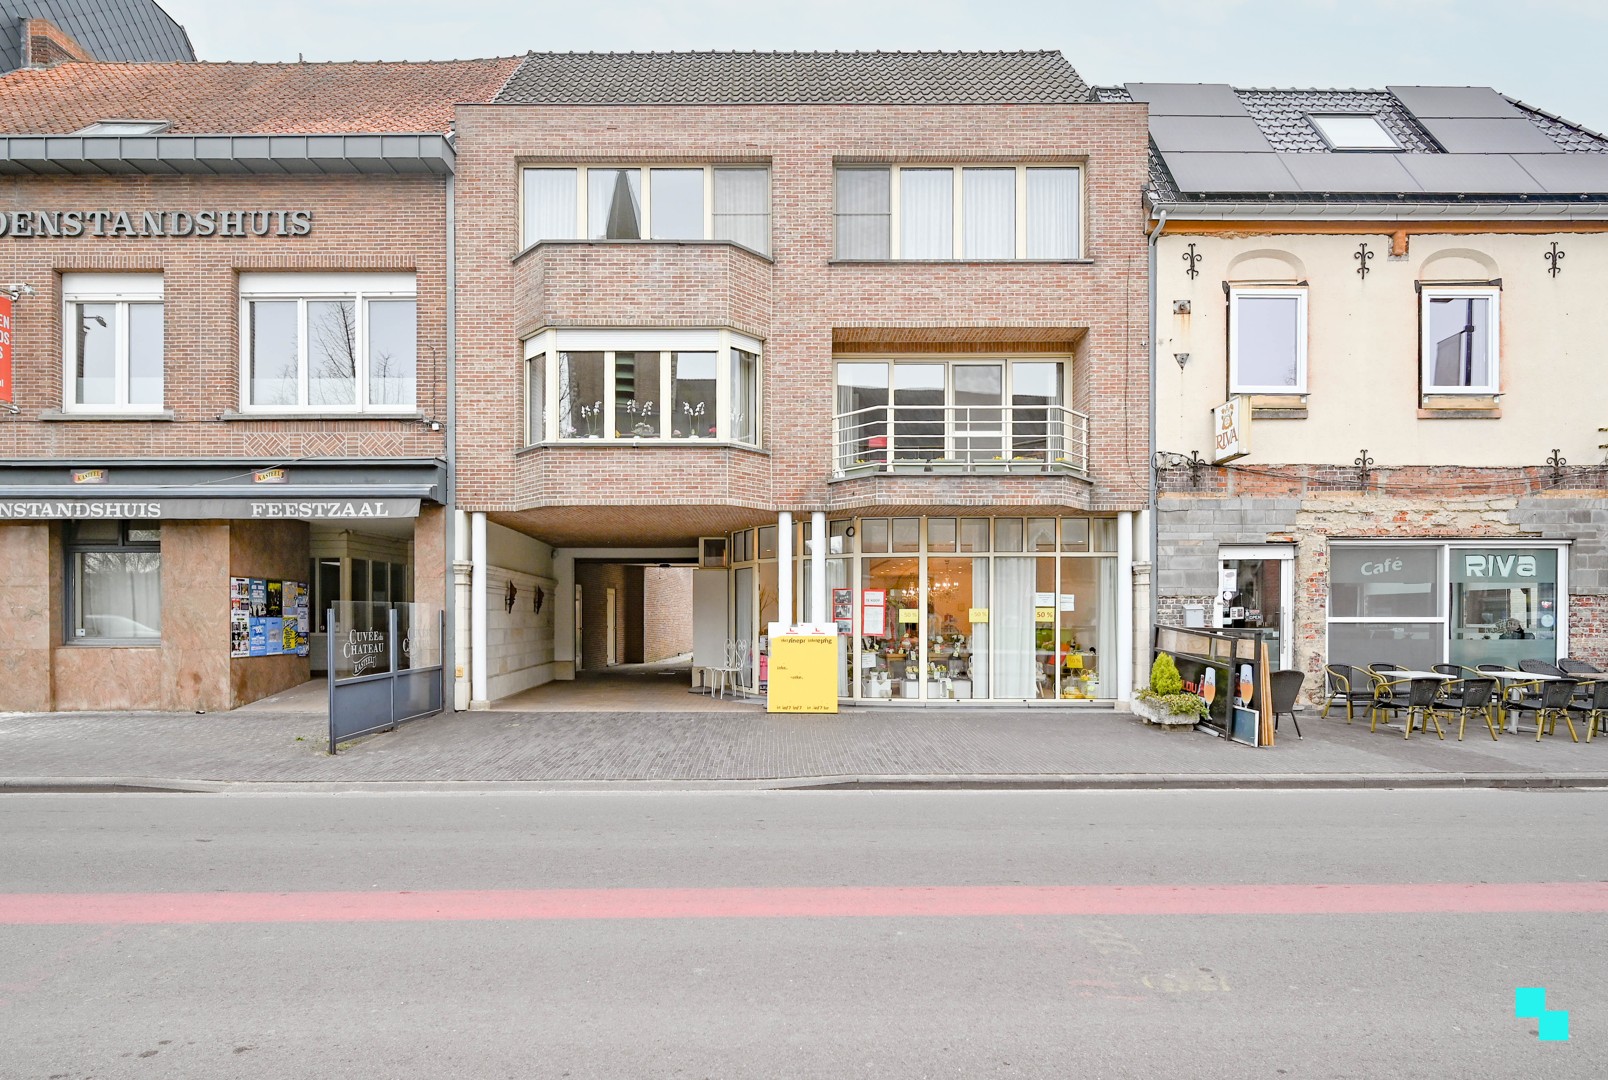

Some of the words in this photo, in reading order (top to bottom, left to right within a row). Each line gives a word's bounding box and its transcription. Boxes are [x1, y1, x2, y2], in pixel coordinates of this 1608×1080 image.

[1216, 427, 1238, 450] RIVA
[257, 470, 281, 481] KASTEEL
[250, 502, 389, 518] FEESTZAAL
[1360, 557, 1403, 576] Café
[343, 642, 384, 658] CHATEAU
